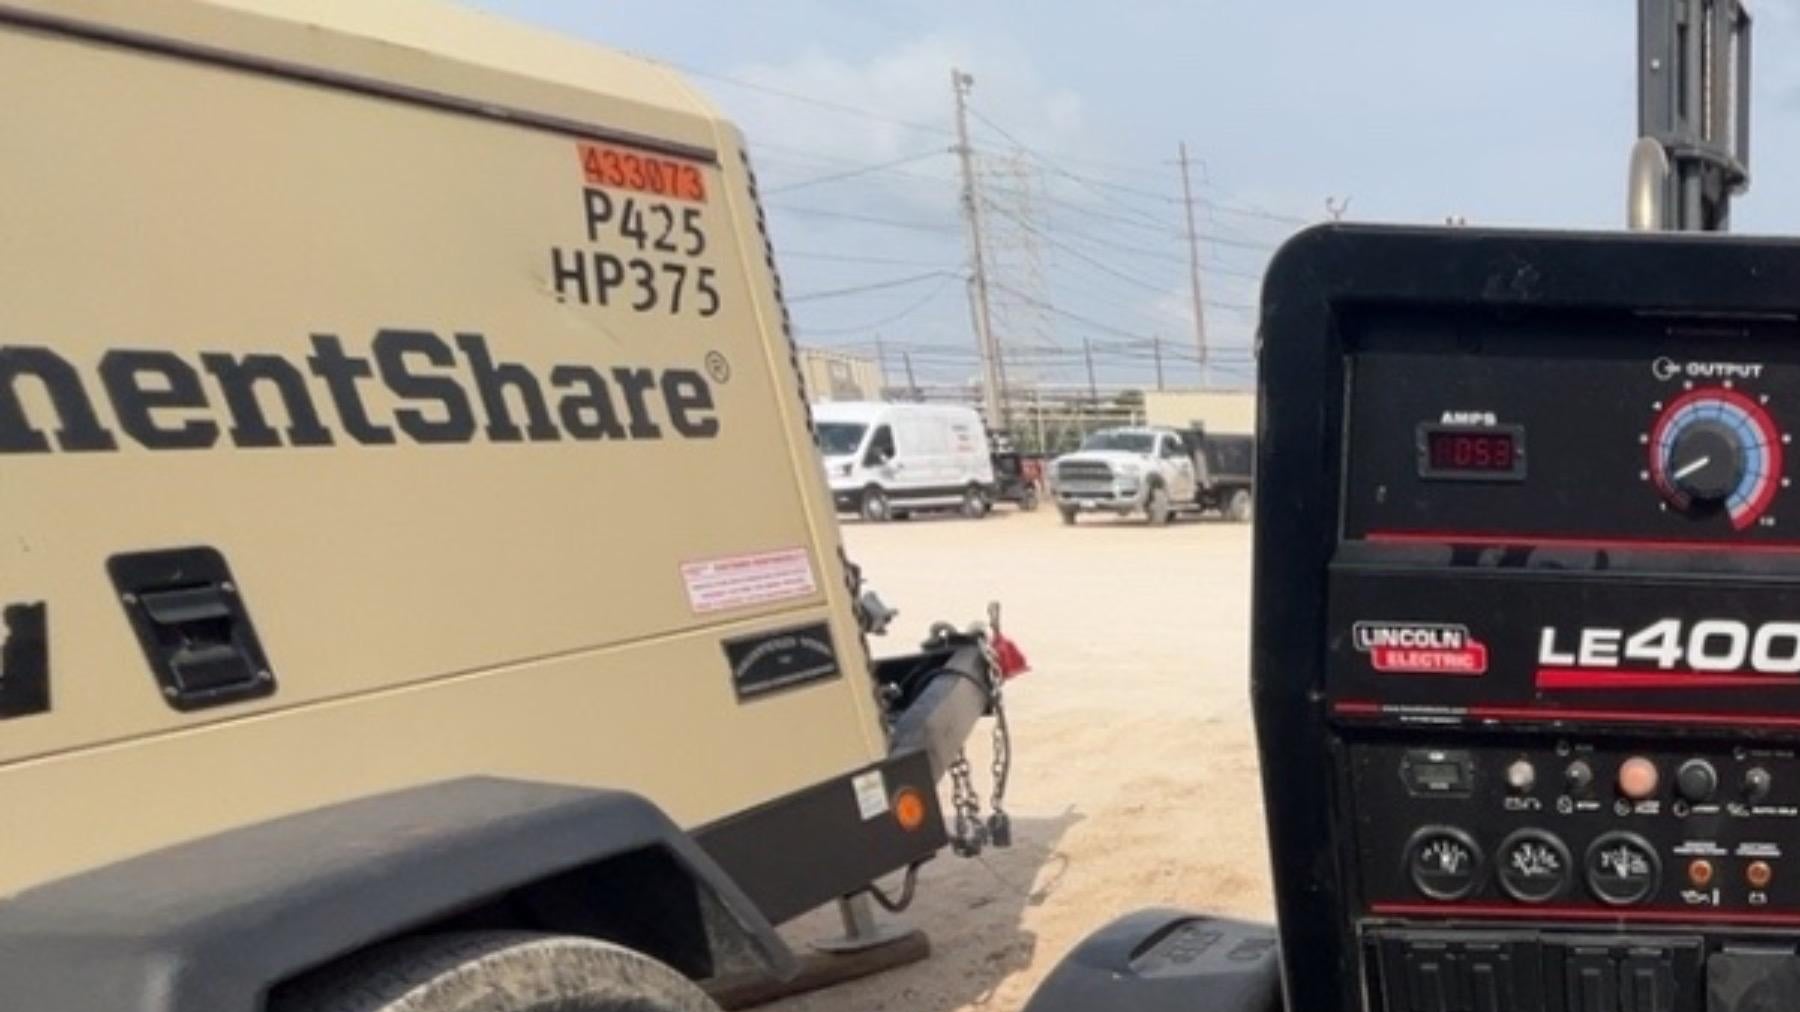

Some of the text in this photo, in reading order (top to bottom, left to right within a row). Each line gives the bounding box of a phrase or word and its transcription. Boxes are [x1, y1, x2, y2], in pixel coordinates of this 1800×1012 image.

[583, 186, 706, 257] P425
[552, 247, 721, 318] HP375
[1686, 362, 1763, 378] OUTPUT
[1440, 410, 1498, 426] AMPS
[1360, 627, 1462, 648] LINCOLN
[1385, 651, 1474, 668] ELECTRIC
